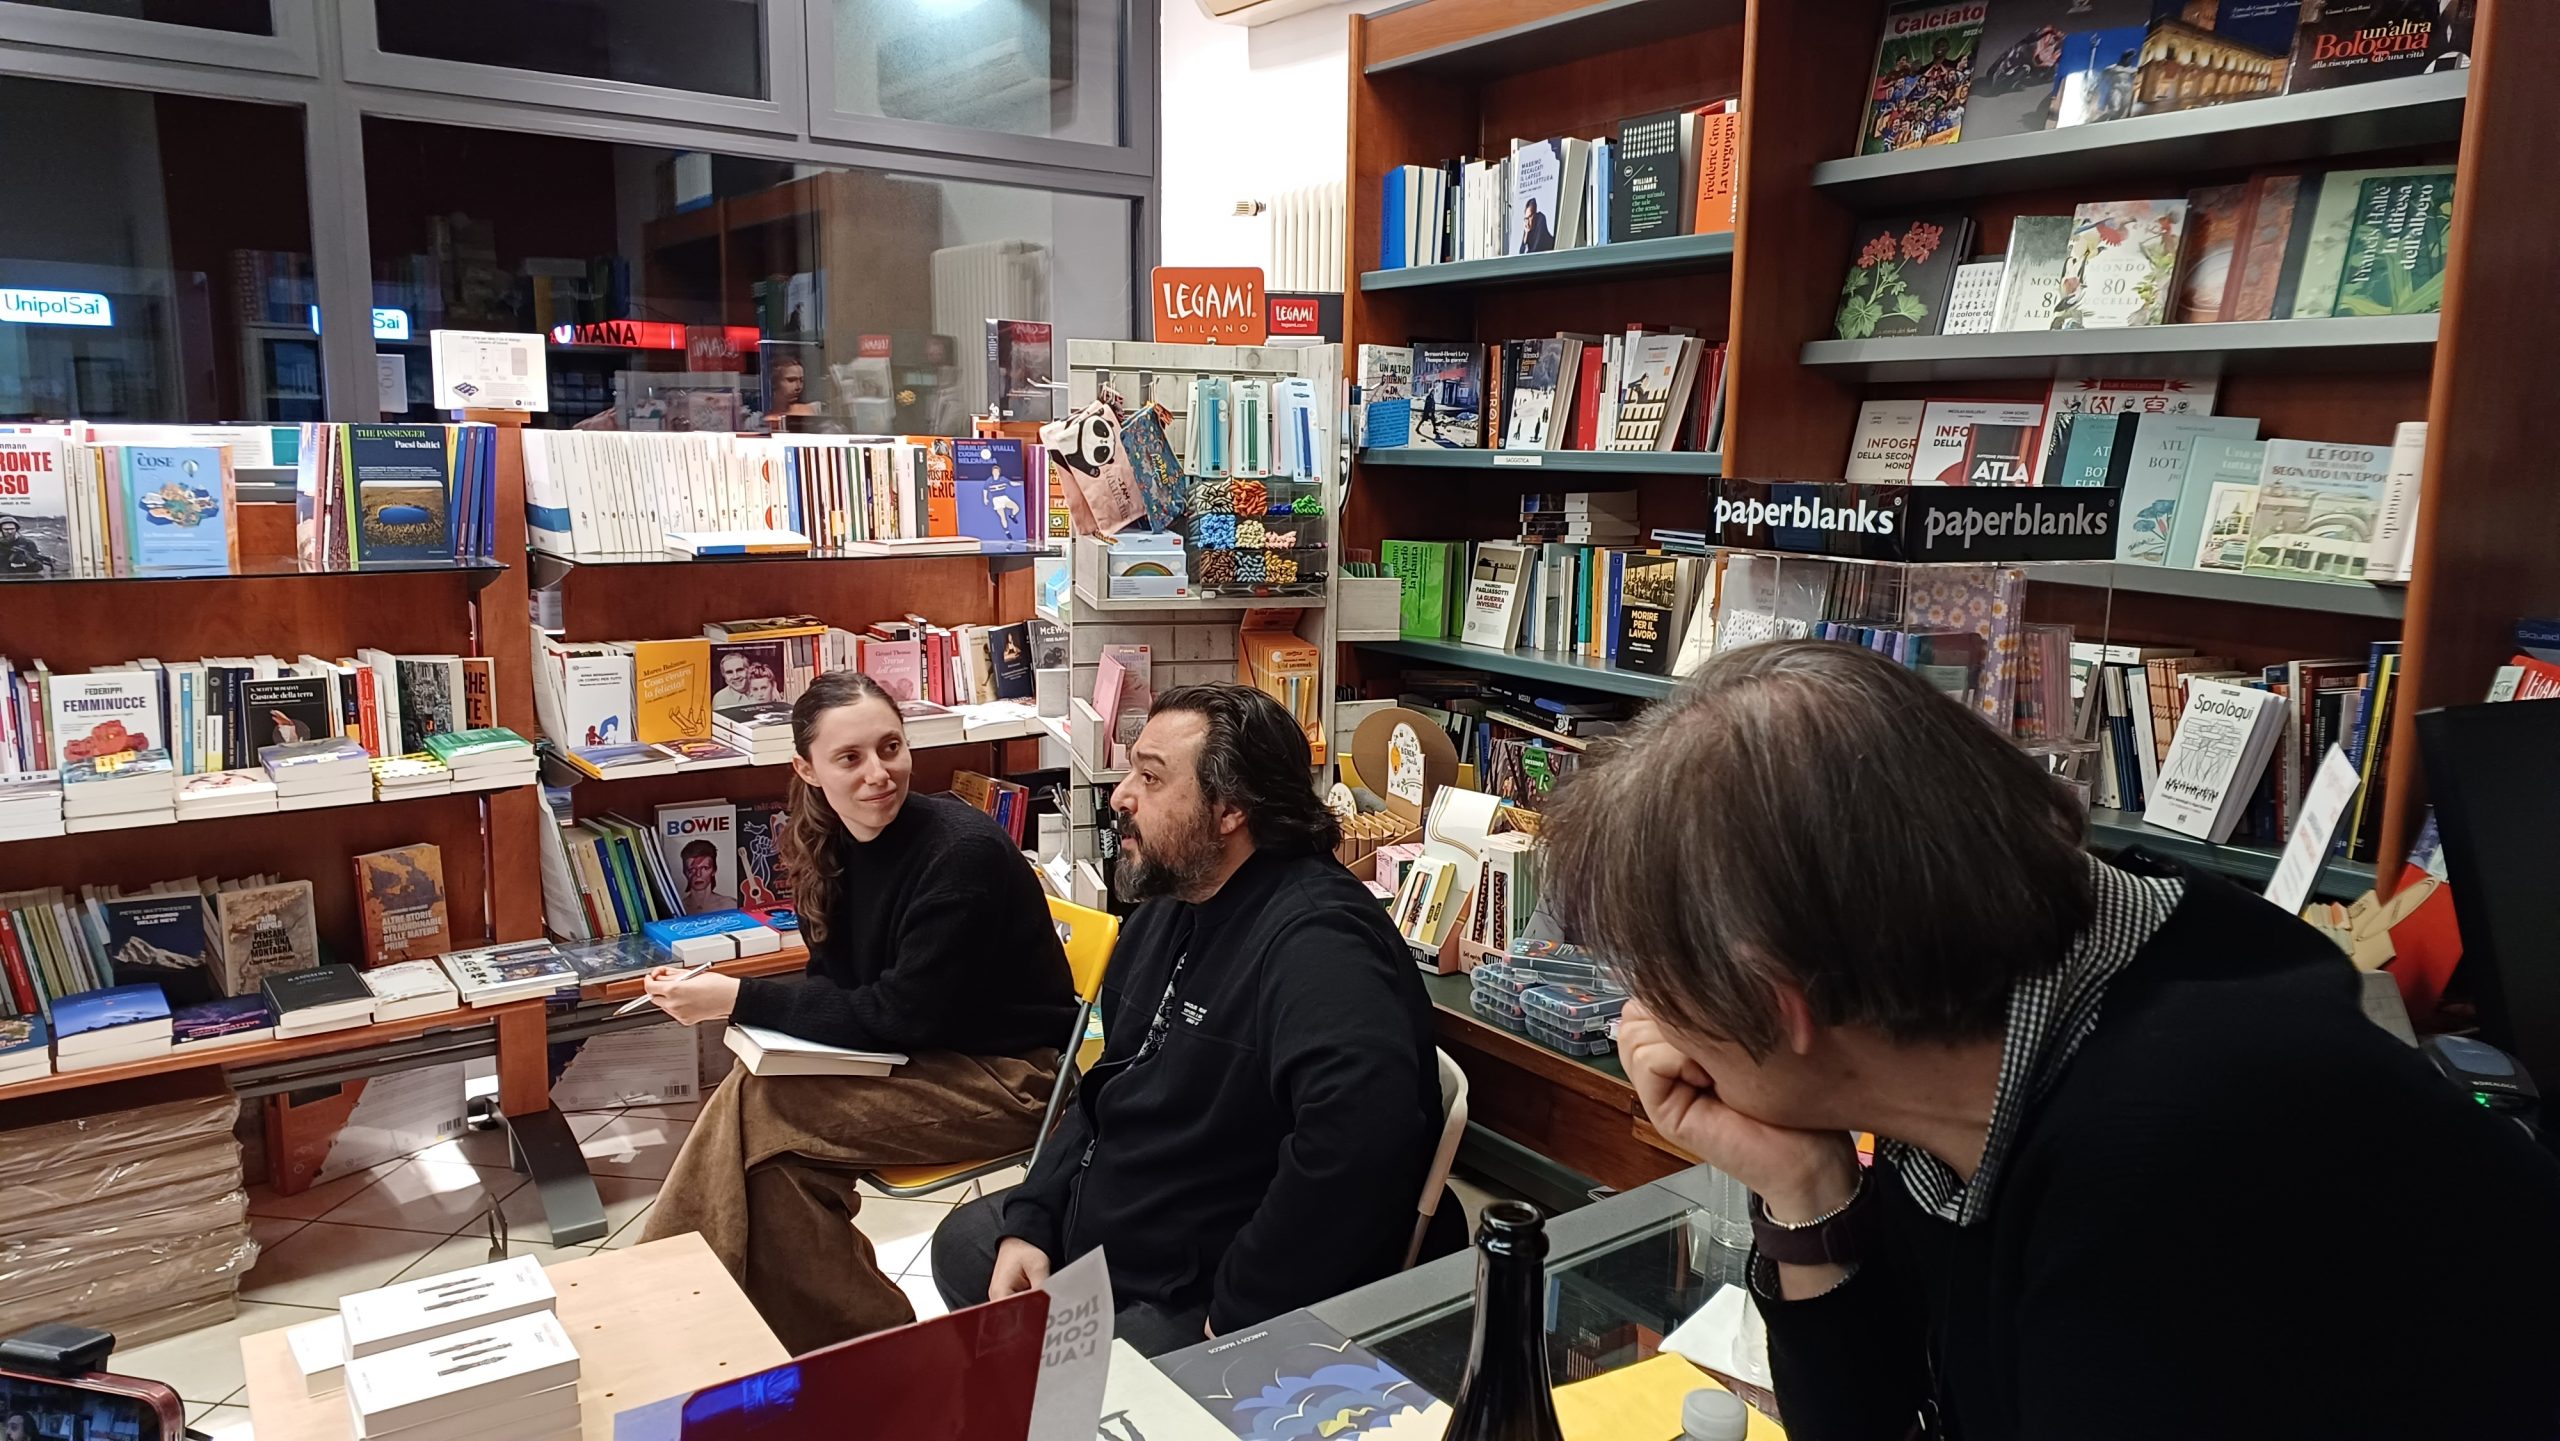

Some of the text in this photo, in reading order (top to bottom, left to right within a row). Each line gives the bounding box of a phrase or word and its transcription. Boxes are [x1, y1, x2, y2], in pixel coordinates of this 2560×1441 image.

[2362, 19, 2432, 41] un'altra
[2311, 31, 2430, 63] Bologna
[1703, 116, 1722, 201] Frédéric Gros
[1716, 116, 1736, 196] La vergogna
[1521, 160, 1542, 169] MASSIMO
[1633, 177, 1652, 186] WILLIAM
[2383, 184, 2413, 254] In difesa
[2350, 186, 2391, 283] Francis Hallé
[2400, 184, 2435, 270] dell'albero
[2102, 278, 2126, 295] 80
[4, 293, 101, 317] UnipolSai
[2041, 292, 2058, 308] 8
[1173, 324, 1249, 334] MILANO
[1379, 363, 1411, 374] UN ALTRO
[1381, 375, 1408, 385] GIORNO
[356, 429, 426, 439] THE PASSENGER
[394, 440, 441, 450] Paesi baltici
[1933, 438, 1962, 447] DELLA
[137, 456, 174, 468] COSE
[1857, 451, 1883, 460] DELLA
[2306, 447, 2375, 463] LE FOTO
[1972, 460, 2029, 482] ATLA
[2271, 465, 2331, 480] SEGNATO
[2383, 471, 2414, 539] Leonardo
[1714, 496, 1894, 536] paperblanks
[1925, 502, 2109, 549] paperblanks
[1410, 546, 1419, 579] pianta
[1484, 595, 1505, 603] GUERRA
[1631, 610, 1659, 621] MORIRE
[1633, 620, 1654, 630] PER IL
[1628, 628, 1657, 640] LAVORO
[882, 657, 904, 666] Storia
[643, 676, 662, 689] Cosa
[63, 696, 147, 713] FEMMINUCCE
[2194, 693, 2255, 721] Sprolòqui
[666, 816, 730, 836] BOWIE
[141, 912, 180, 920] LEOPARDO
[382, 914, 405, 926] ALTRE
[405, 909, 432, 922] STORIE
[256, 920, 283, 931] LEOPOLD
[383, 916, 442, 934] STRAORDINARIE
[253, 928, 287, 940] PENSARE
[384, 925, 440, 943] DELLE MATERIE
[252, 936, 290, 948] COME UNA
[384, 939, 409, 951] PRIME
[251, 946, 293, 957] MONTAGNA
